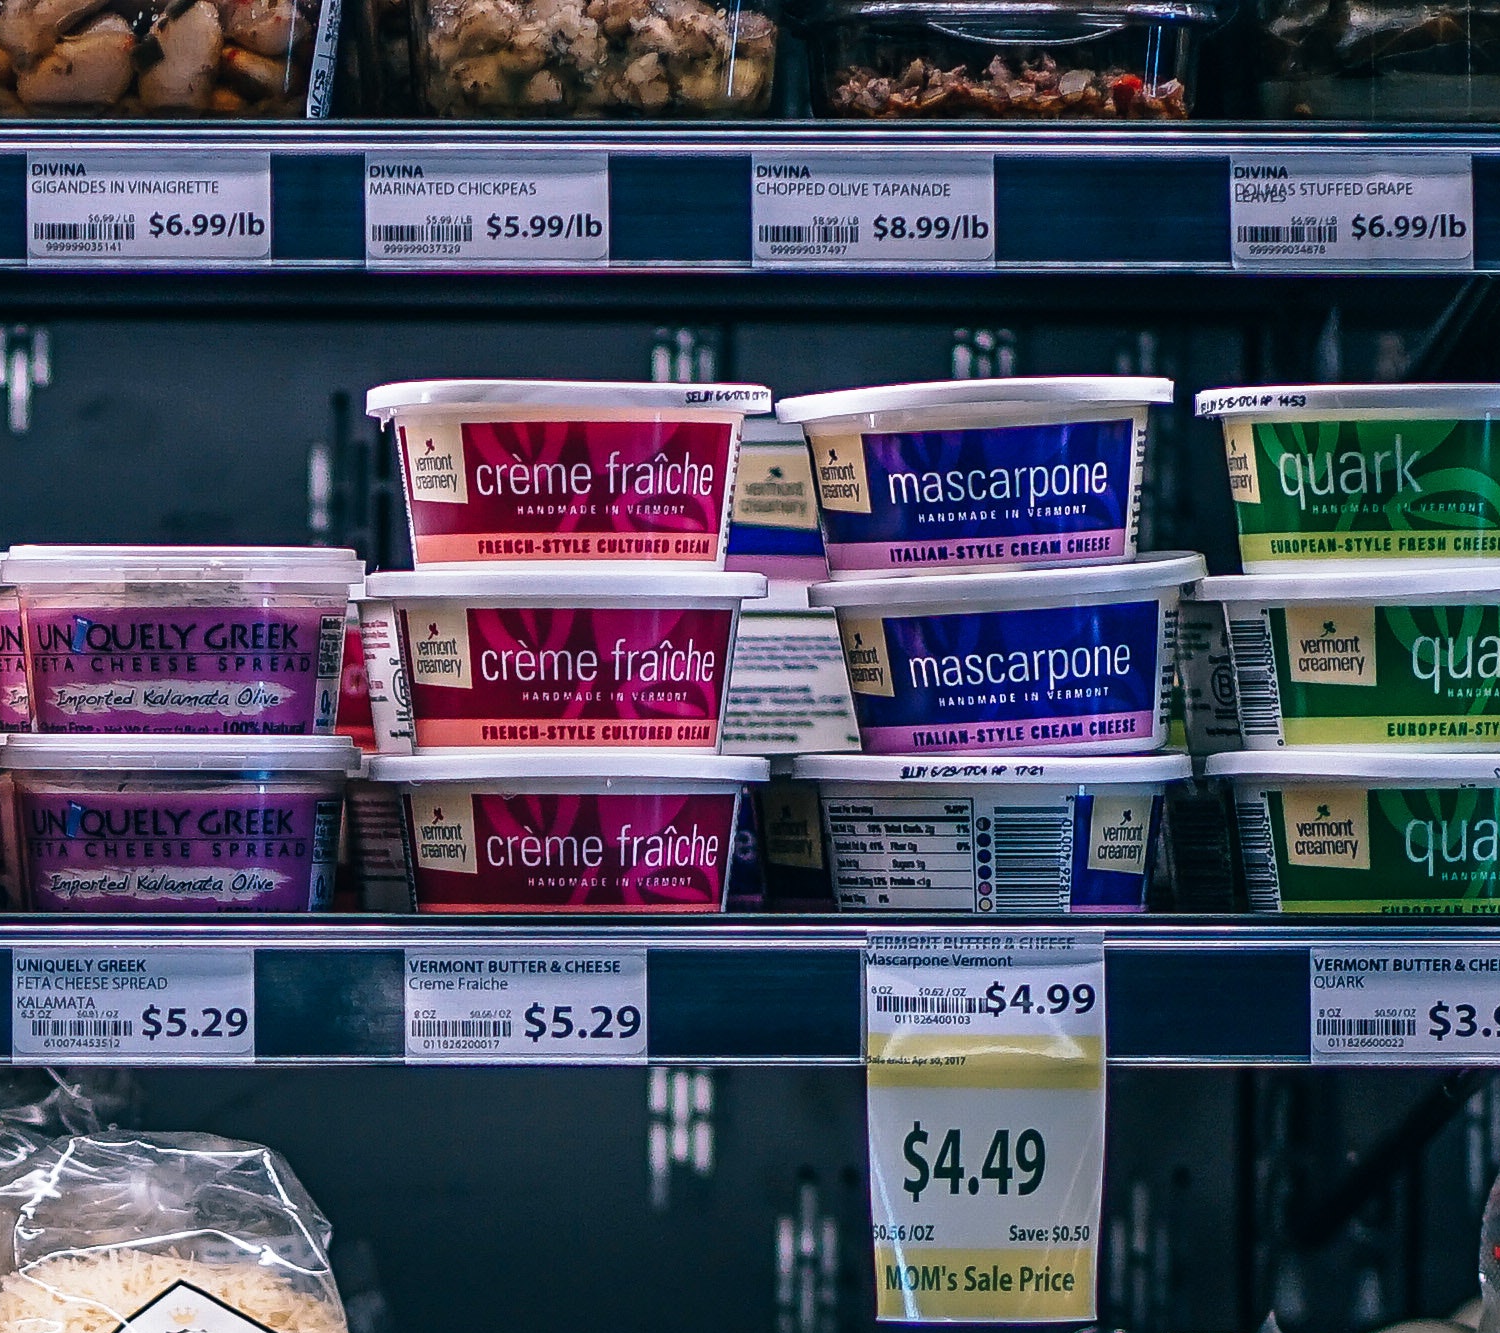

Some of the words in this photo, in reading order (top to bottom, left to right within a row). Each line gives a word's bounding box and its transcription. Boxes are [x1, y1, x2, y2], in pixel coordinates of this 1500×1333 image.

[756, 164, 815, 179] DIVINA
[755, 181, 826, 196] CHOPPED
[828, 182, 869, 197] OLIVE
[872, 182, 951, 198] TAPANADE
[873, 213, 989, 242] $8.99/lb
[476, 453, 592, 496] crème
[605, 450, 714, 496] fraîche
[1276, 433, 1423, 511] quark
[888, 461, 1108, 507] mascarpone
[517, 504, 596, 516] HANDMADE
[605, 504, 619, 515] IN
[626, 504, 685, 516] VERMONT
[477, 538, 591, 555] FRENCH-STYLE
[596, 538, 670, 554] CULTURED
[674, 539, 710, 554] CREAM
[889, 543, 1005, 563] ITALIAN-STYLE
[1010, 539, 1060, 557] CREAM
[1066, 536, 1111, 554] CHEESE
[1270, 536, 1392, 555] EUROPEAN-STYLE
[1398, 536, 1447, 552] FRESH
[56, 687, 136, 709] Imported
[142, 687, 230, 708] Kalamata
[237, 687, 280, 707] Olive
[16, 958, 94, 974] UNIQUELY
[97, 959, 147, 973] GREEK
[1313, 958, 1390, 972] VERMONT
[1392, 958, 1452, 972] BUTTER
[1453, 958, 1466, 972] &
[1313, 974, 1366, 990] QUARK
[141, 1003, 249, 1041] $5.29
[903, 1120, 1046, 1203] $4.49
[885, 1264, 958, 1292] MOM's
[963, 1264, 1013, 1292] Sale
[1019, 1265, 1075, 1292] Price
